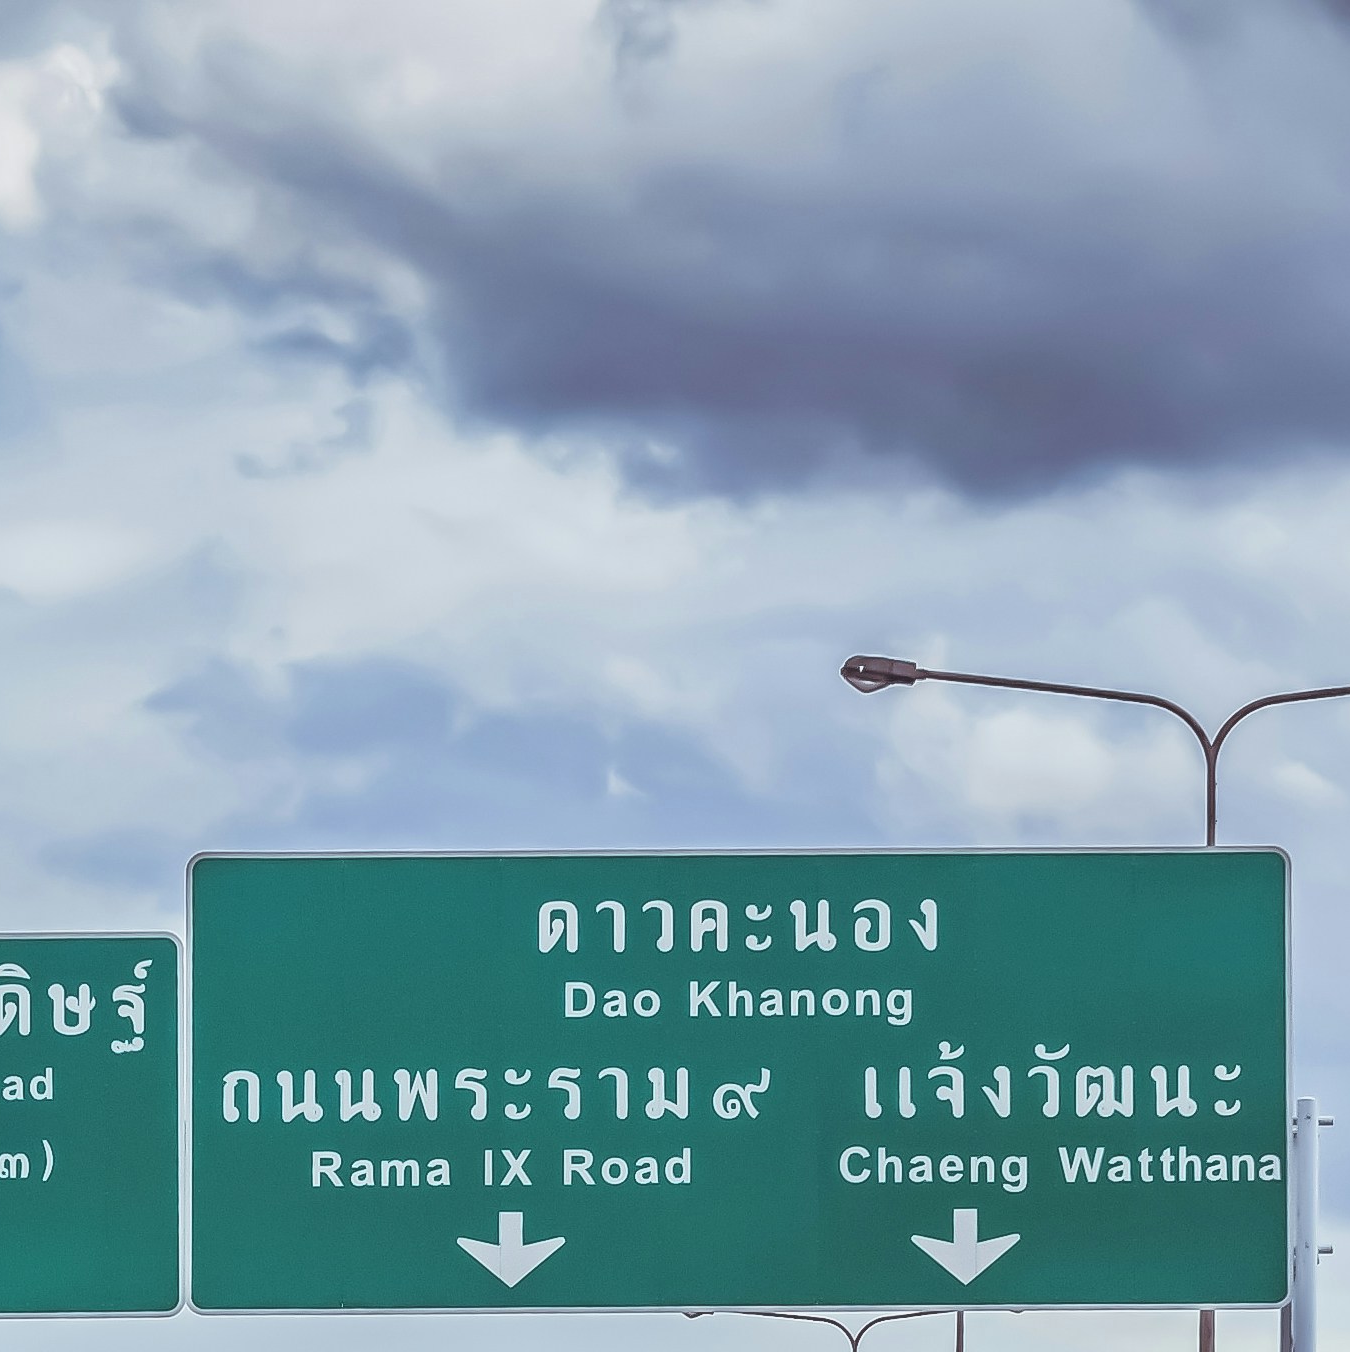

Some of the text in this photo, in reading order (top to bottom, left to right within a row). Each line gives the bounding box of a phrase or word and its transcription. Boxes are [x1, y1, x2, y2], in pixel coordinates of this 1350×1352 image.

[538, 898, 938, 953] ดาวคะนอง
[565, 981, 912, 1026] Dao Khanong
[864, 1041, 1244, 1120] แจ้งวัฒนะ
[312, 1147, 692, 1187] Rama IX Road
[839, 1146, 1282, 1193] Chaeng Watthana
